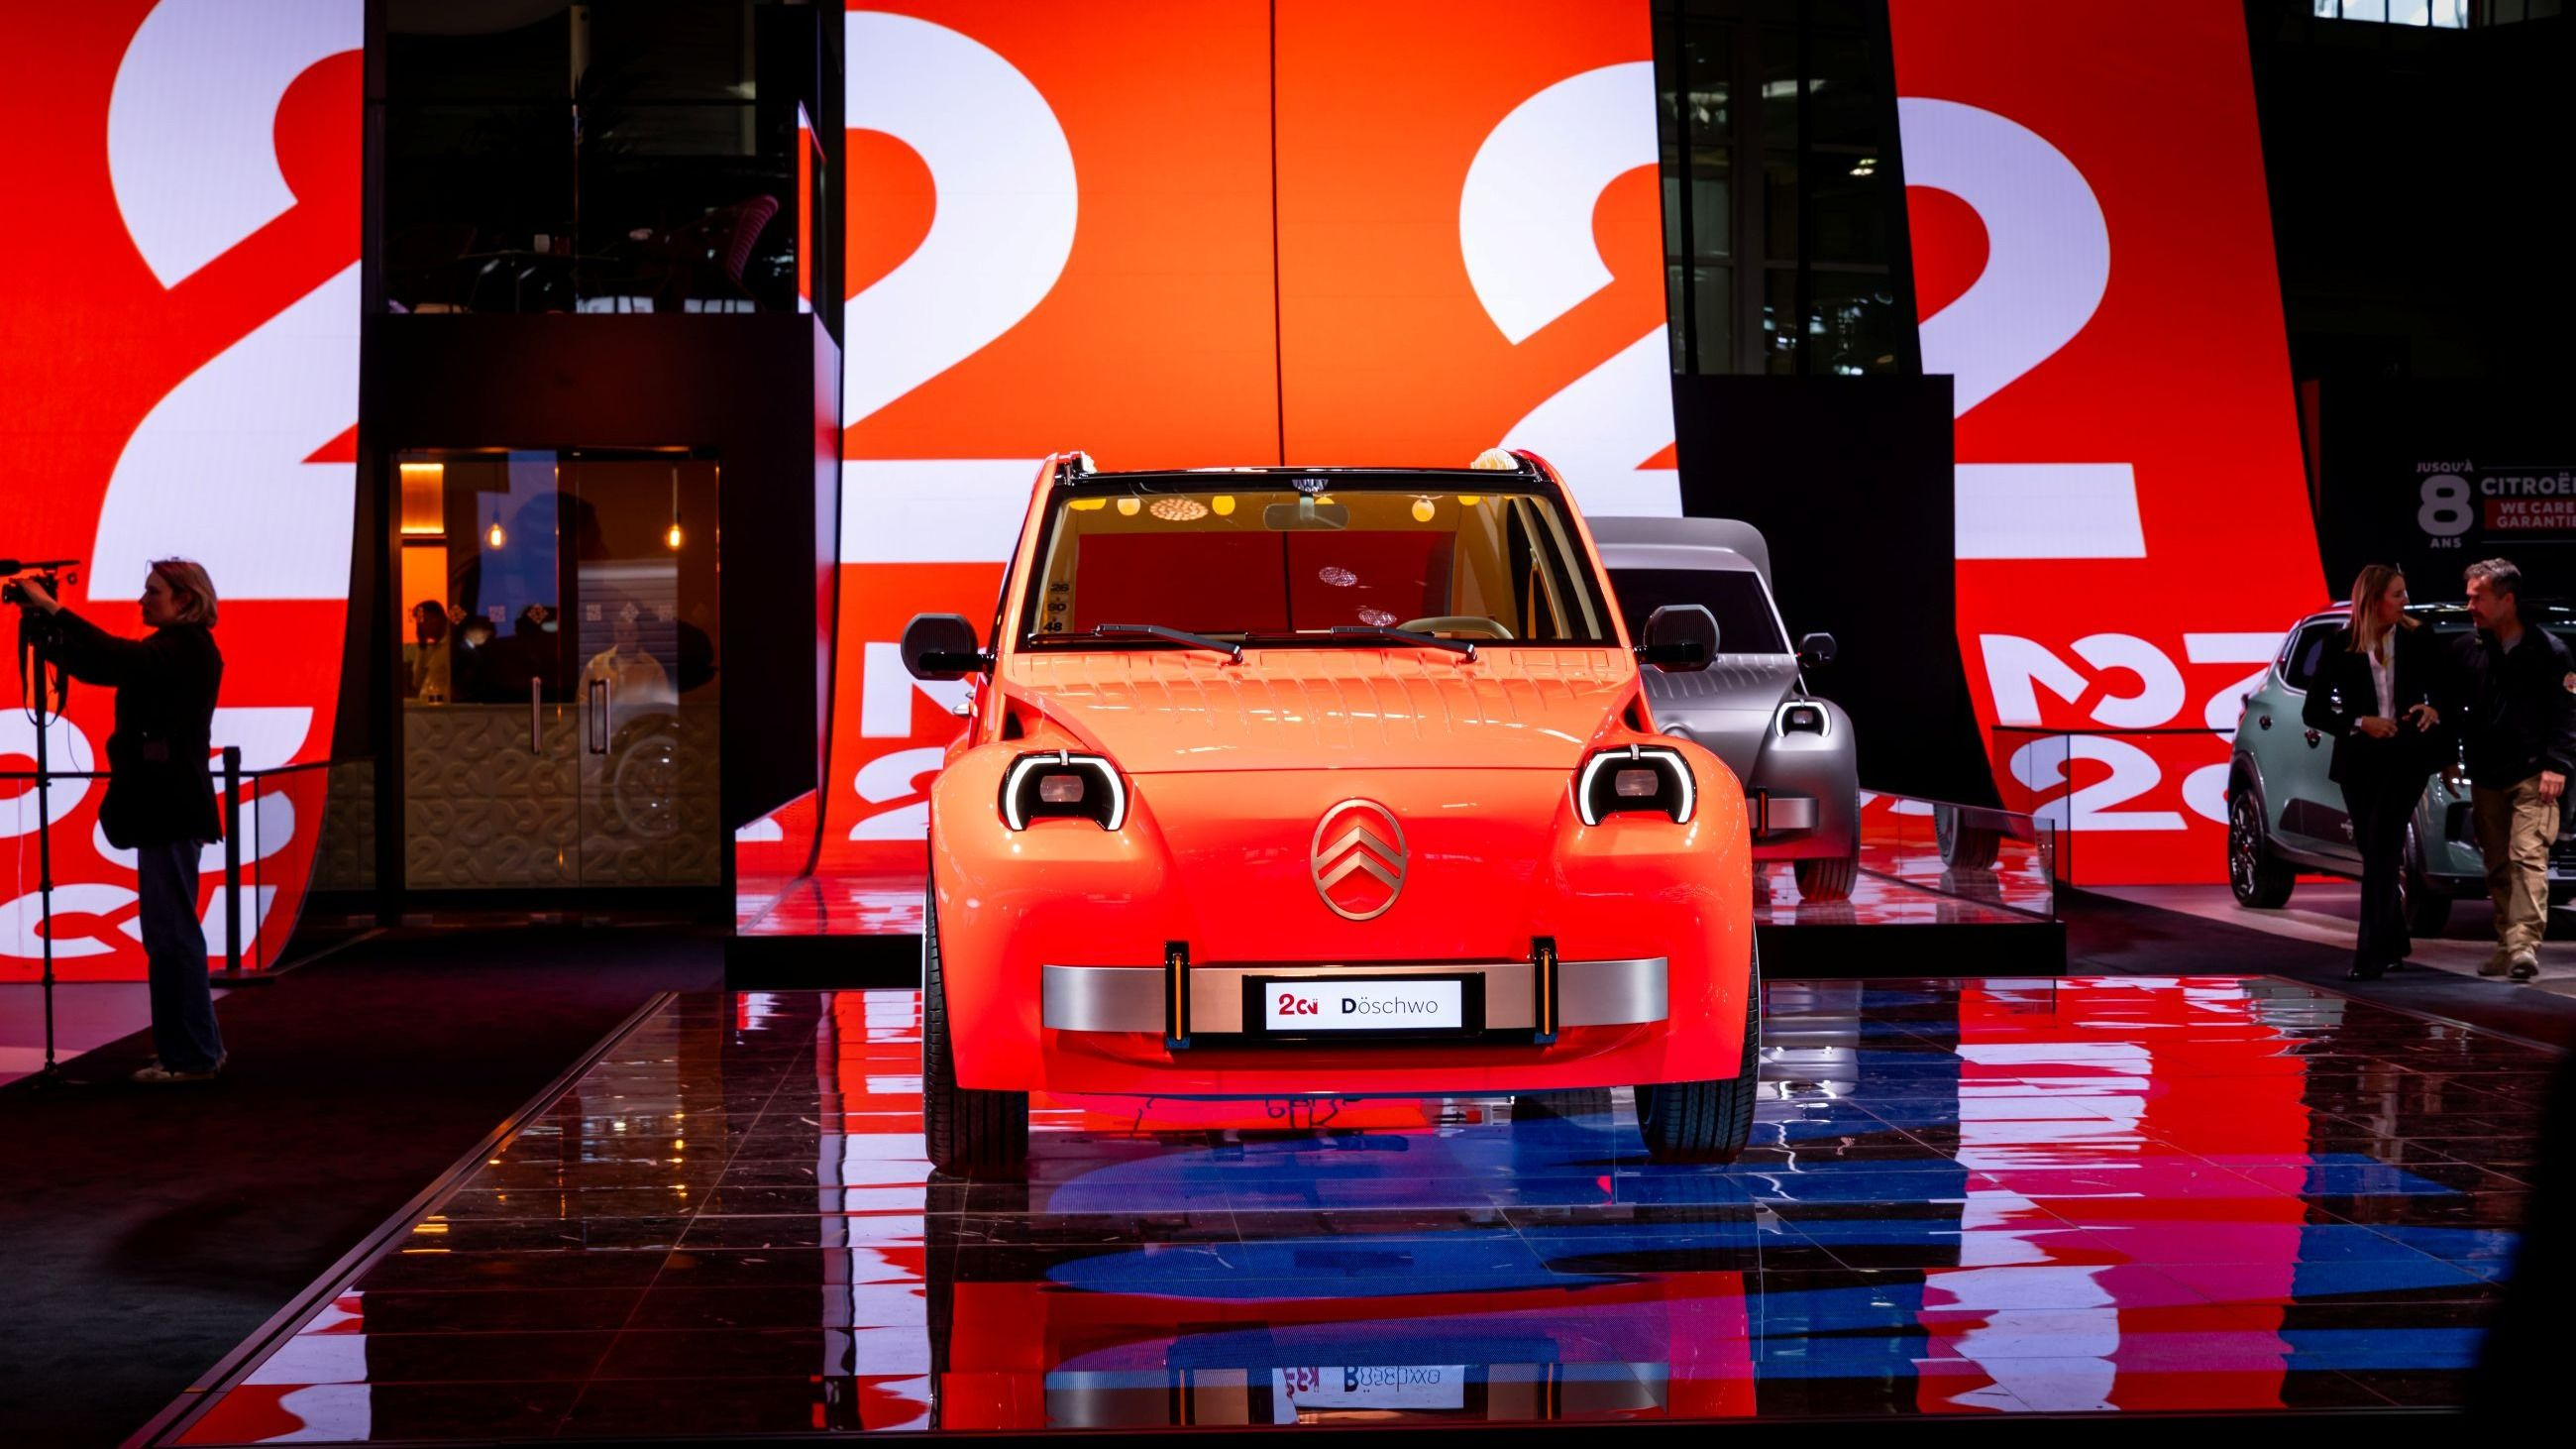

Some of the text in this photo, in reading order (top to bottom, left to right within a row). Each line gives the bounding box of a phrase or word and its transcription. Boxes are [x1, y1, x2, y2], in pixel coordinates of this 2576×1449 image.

[2415, 459, 2474, 473] JUSQU'À
[2480, 472, 2576, 495] CITROË
[2417, 474, 2474, 536] 8
[2500, 502, 2575, 513] WE CARE
[2429, 537, 2462, 548] ANS
[1043, 621, 1063, 631] 48
[1342, 996, 1439, 1014] Döschwo
